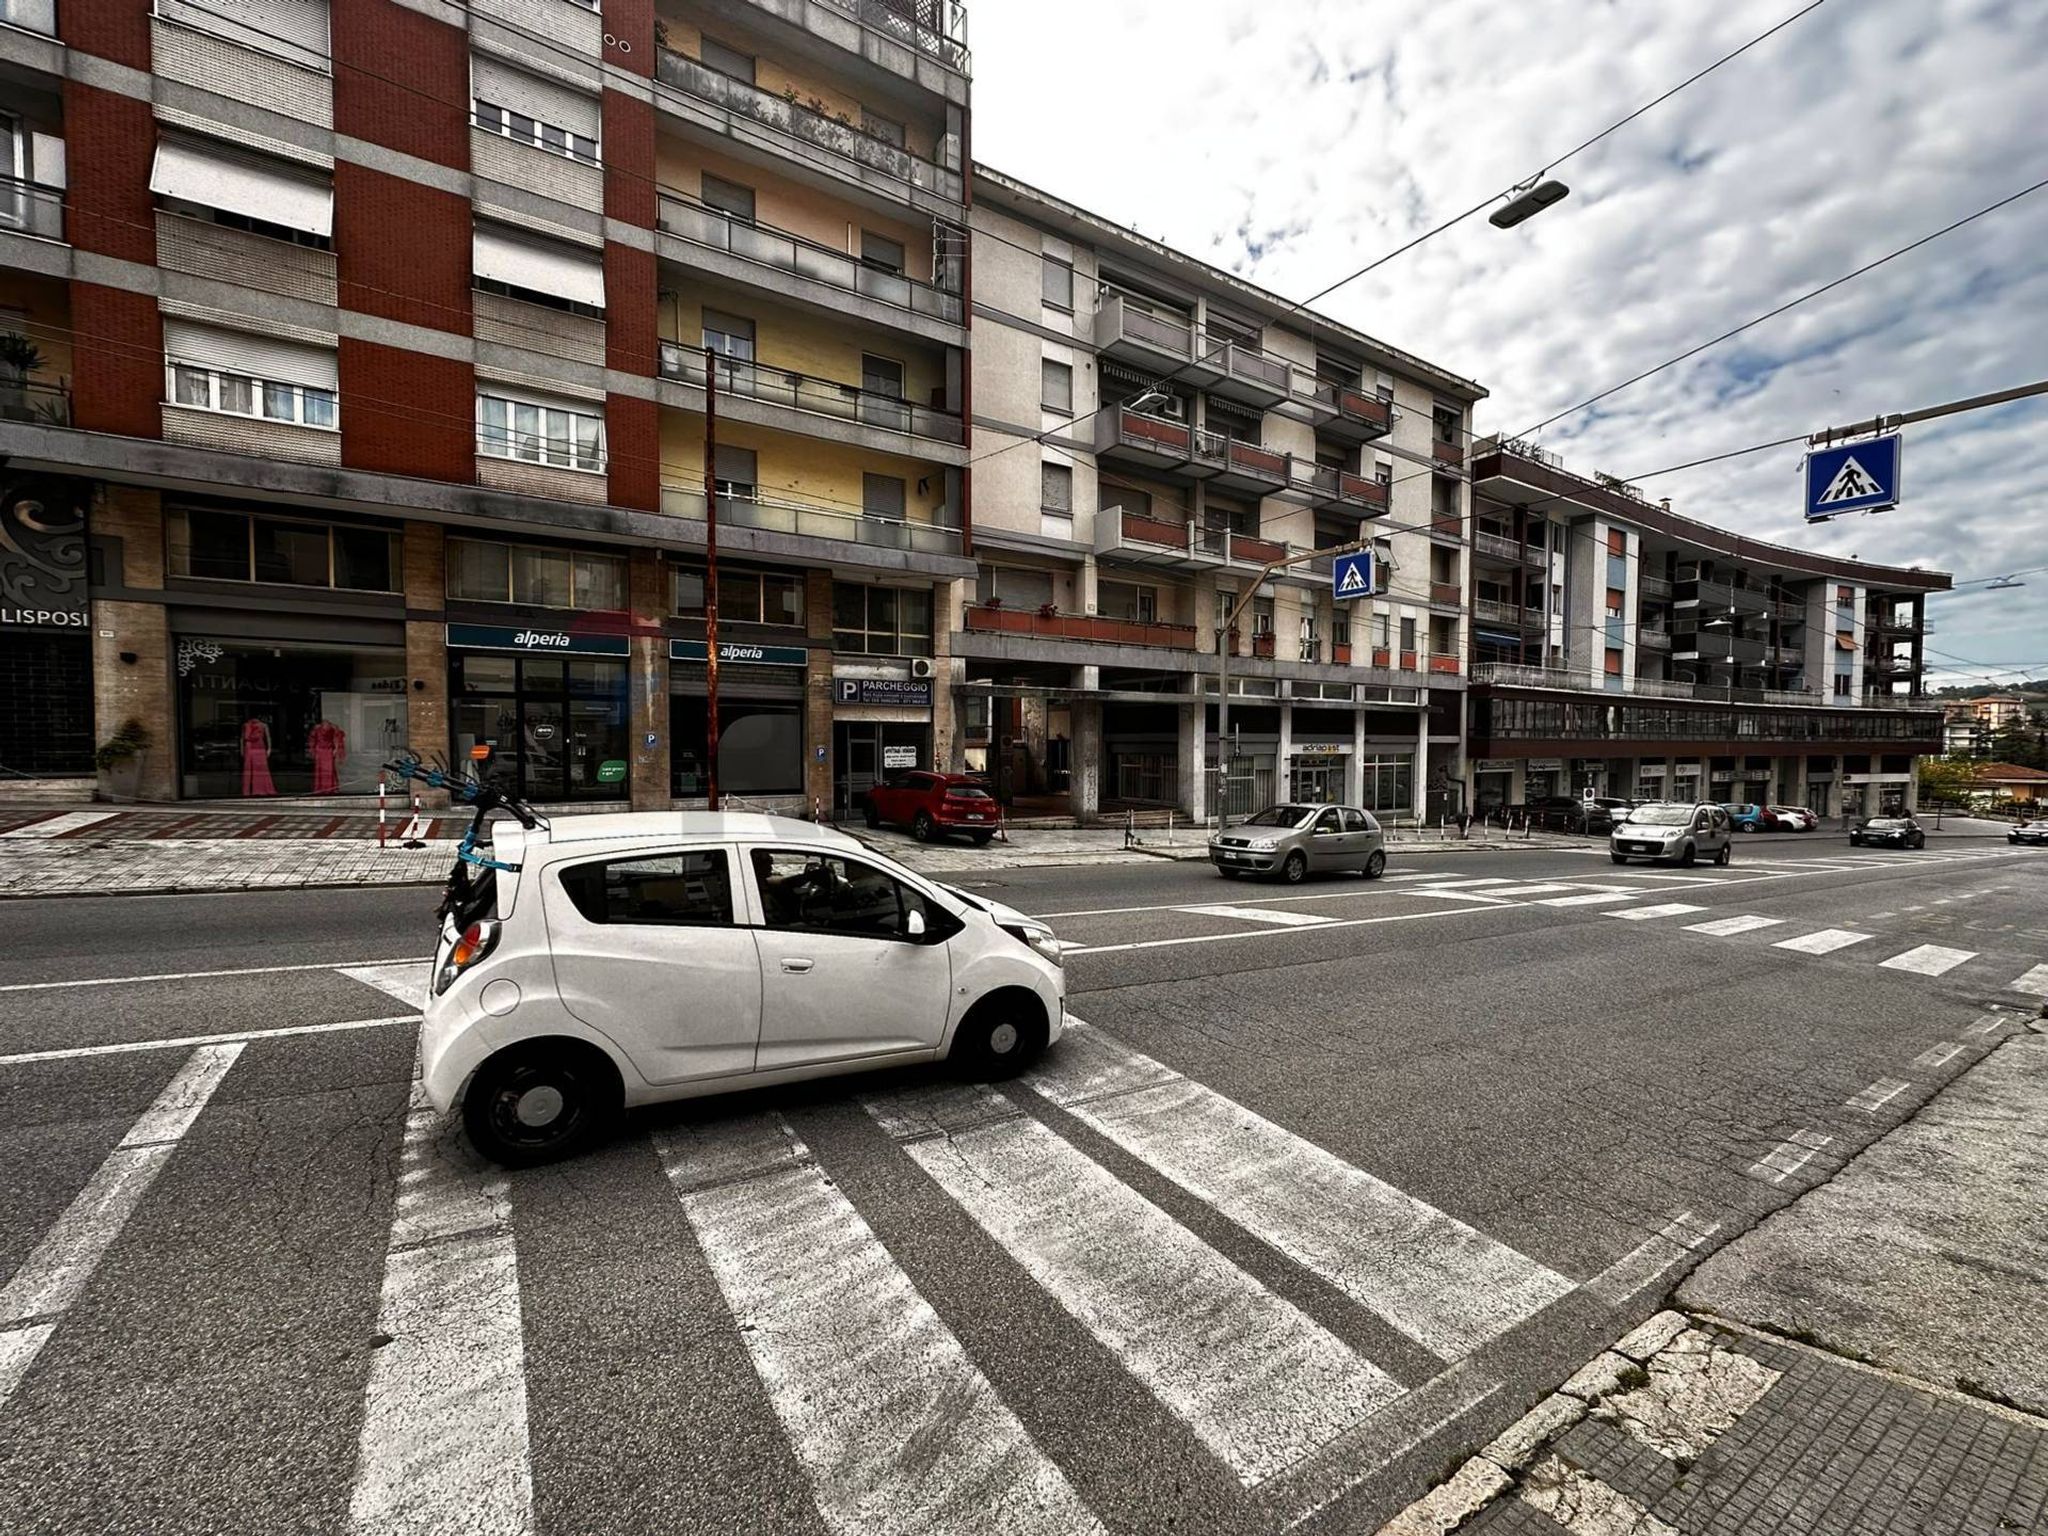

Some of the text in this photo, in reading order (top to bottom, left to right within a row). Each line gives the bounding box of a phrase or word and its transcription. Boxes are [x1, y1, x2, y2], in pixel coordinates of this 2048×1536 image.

[1, 608, 88, 627] LISPOSI
[514, 630, 570, 648] alperia
[720, 645, 763, 660] alperia
[843, 681, 857, 699] P
[862, 680, 928, 692] PARCHEGGIO
[648, 734, 655, 743] P
[818, 748, 825, 756] P
